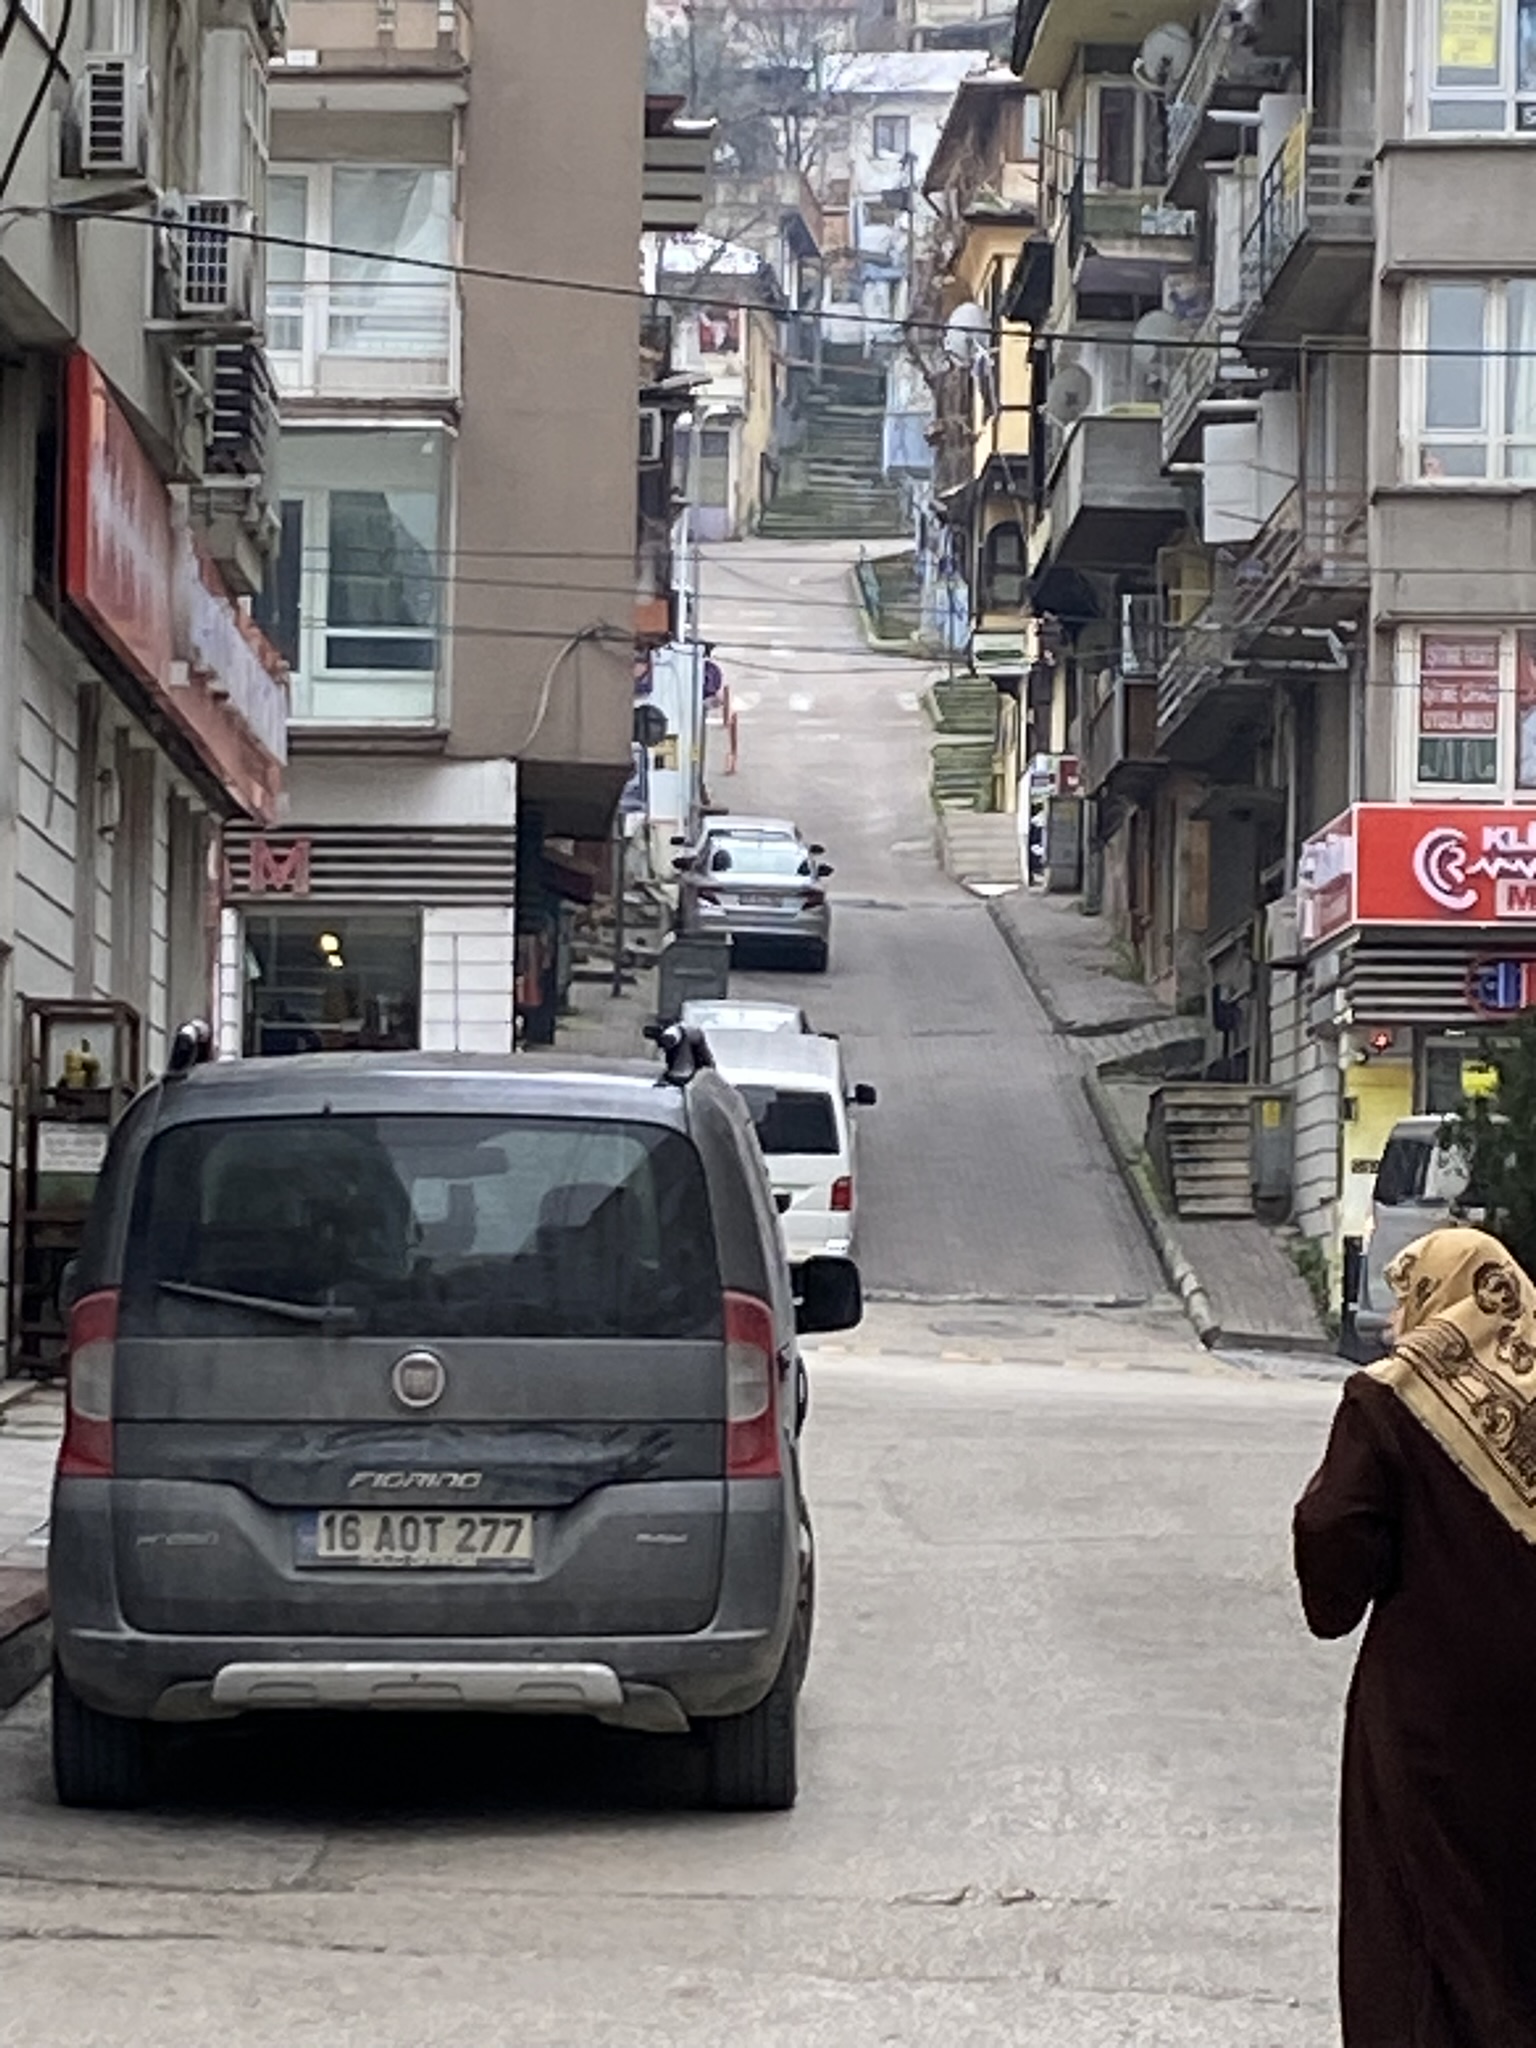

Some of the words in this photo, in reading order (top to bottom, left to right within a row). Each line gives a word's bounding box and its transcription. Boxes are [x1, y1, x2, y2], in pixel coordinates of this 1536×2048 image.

[347, 1471, 483, 1489] FIORINO
[322, 1513, 362, 1552] 16
[374, 1514, 446, 1553] AOT
[455, 1516, 525, 1554] 277
